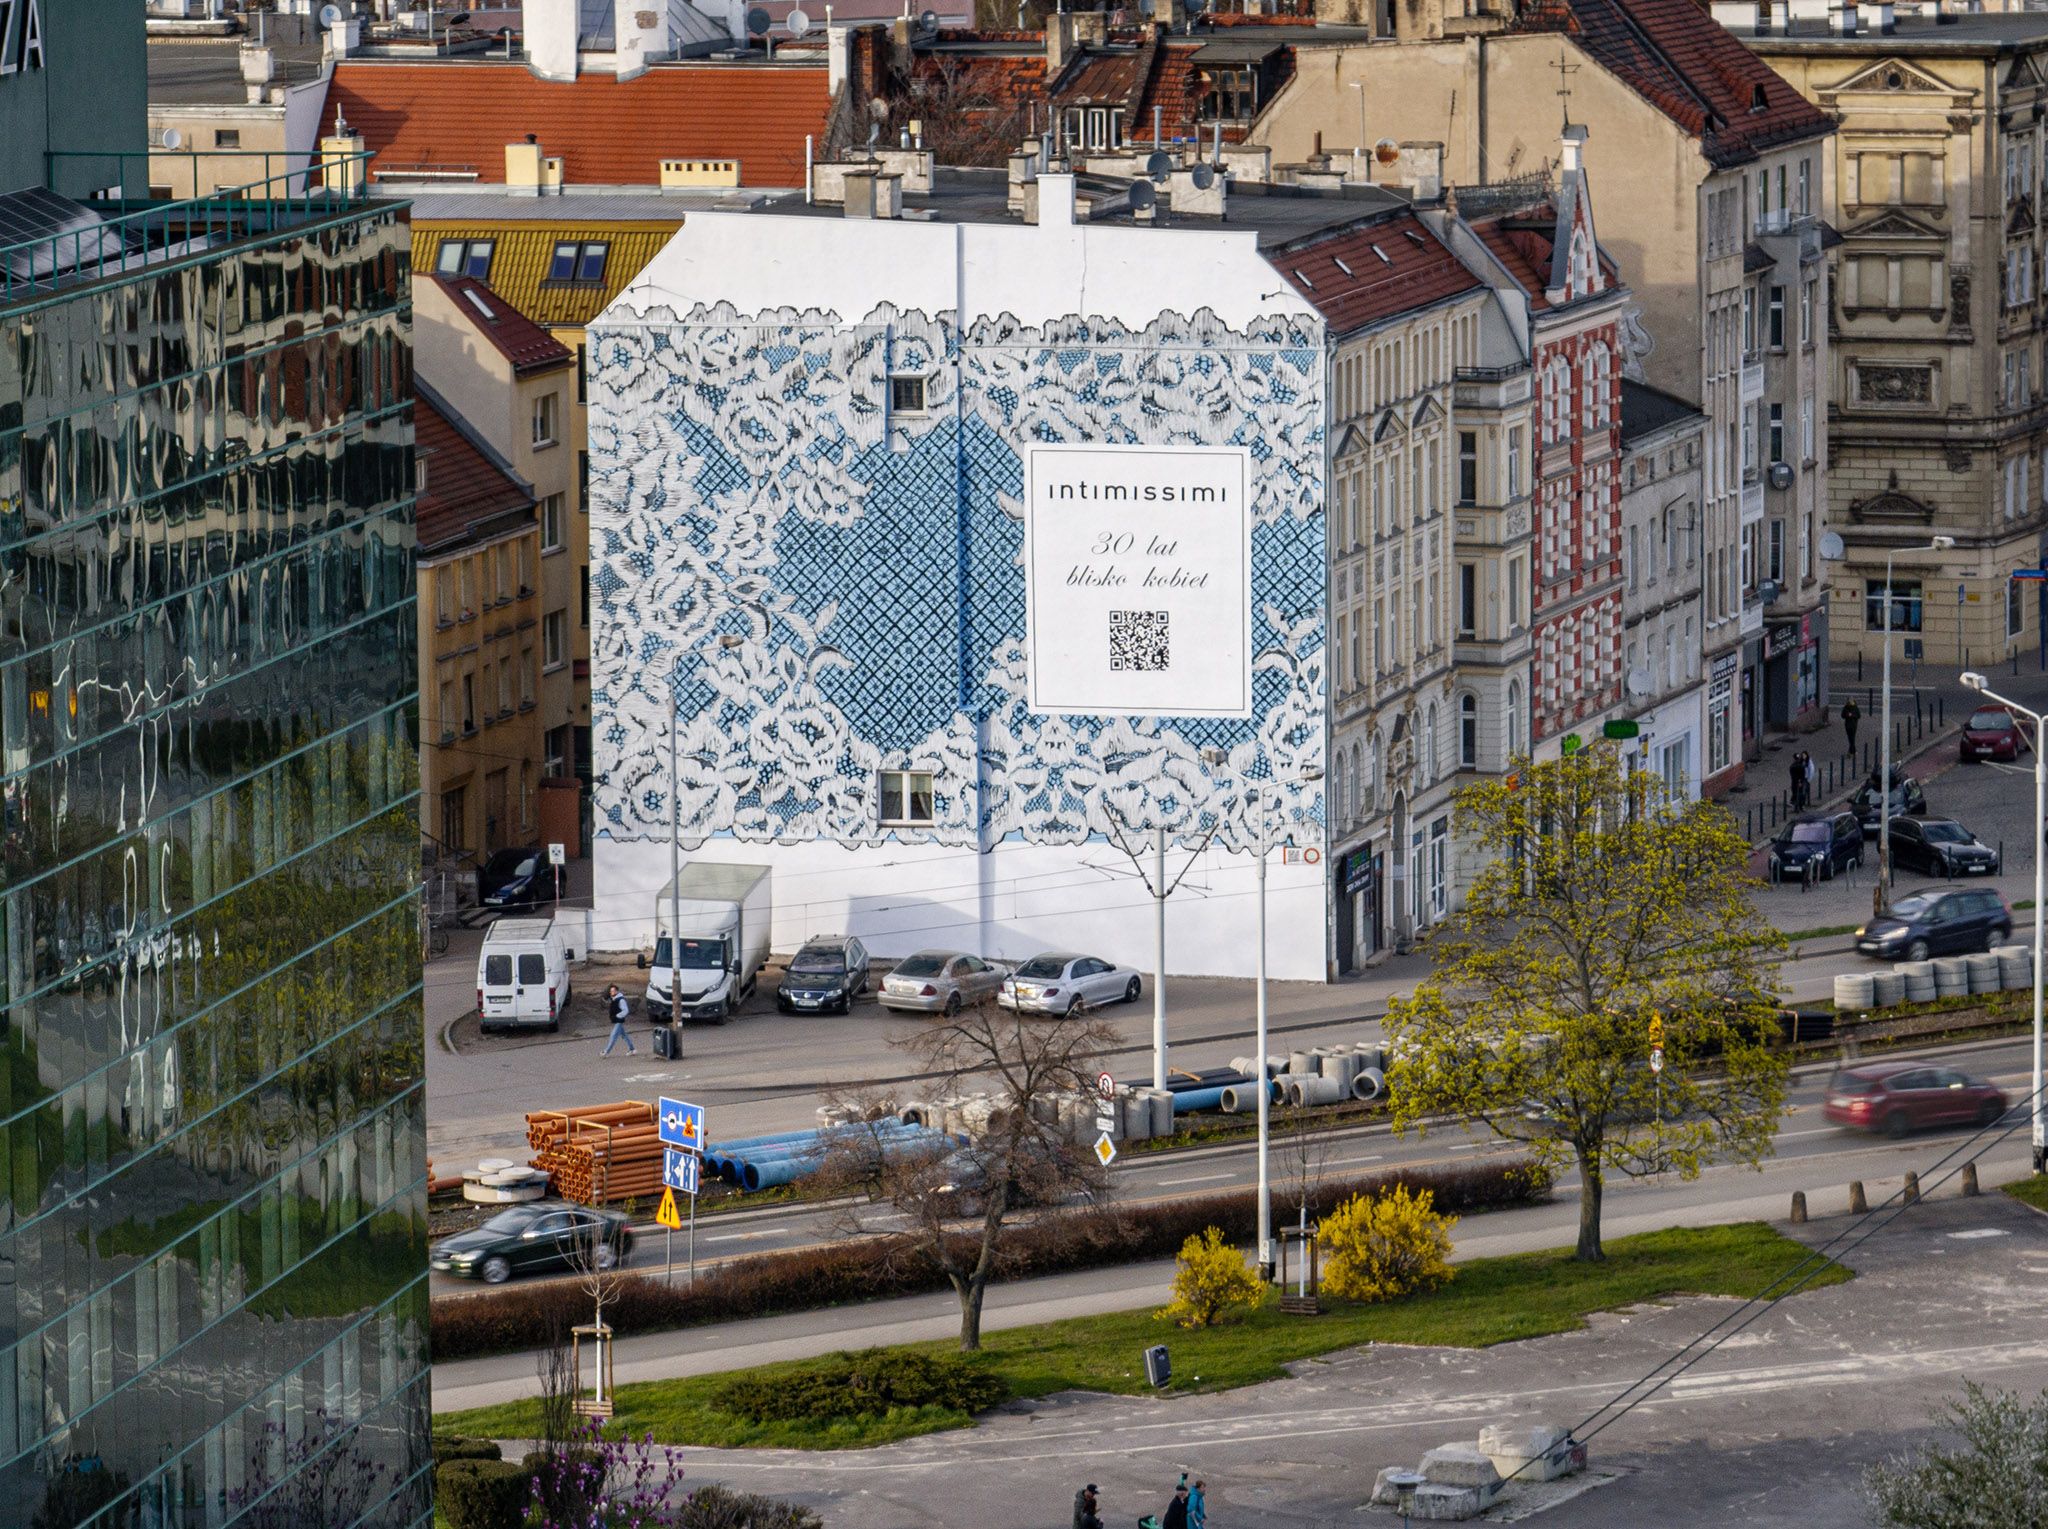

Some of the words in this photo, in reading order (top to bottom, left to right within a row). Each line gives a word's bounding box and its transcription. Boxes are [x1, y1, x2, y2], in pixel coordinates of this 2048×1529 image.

[1049, 480, 1226, 502] intimissimi
[1091, 531, 1135, 555] 30
[1146, 535, 1178, 556] lat
[1066, 565, 1127, 587] blisko
[1142, 566, 1209, 588] kobiet
